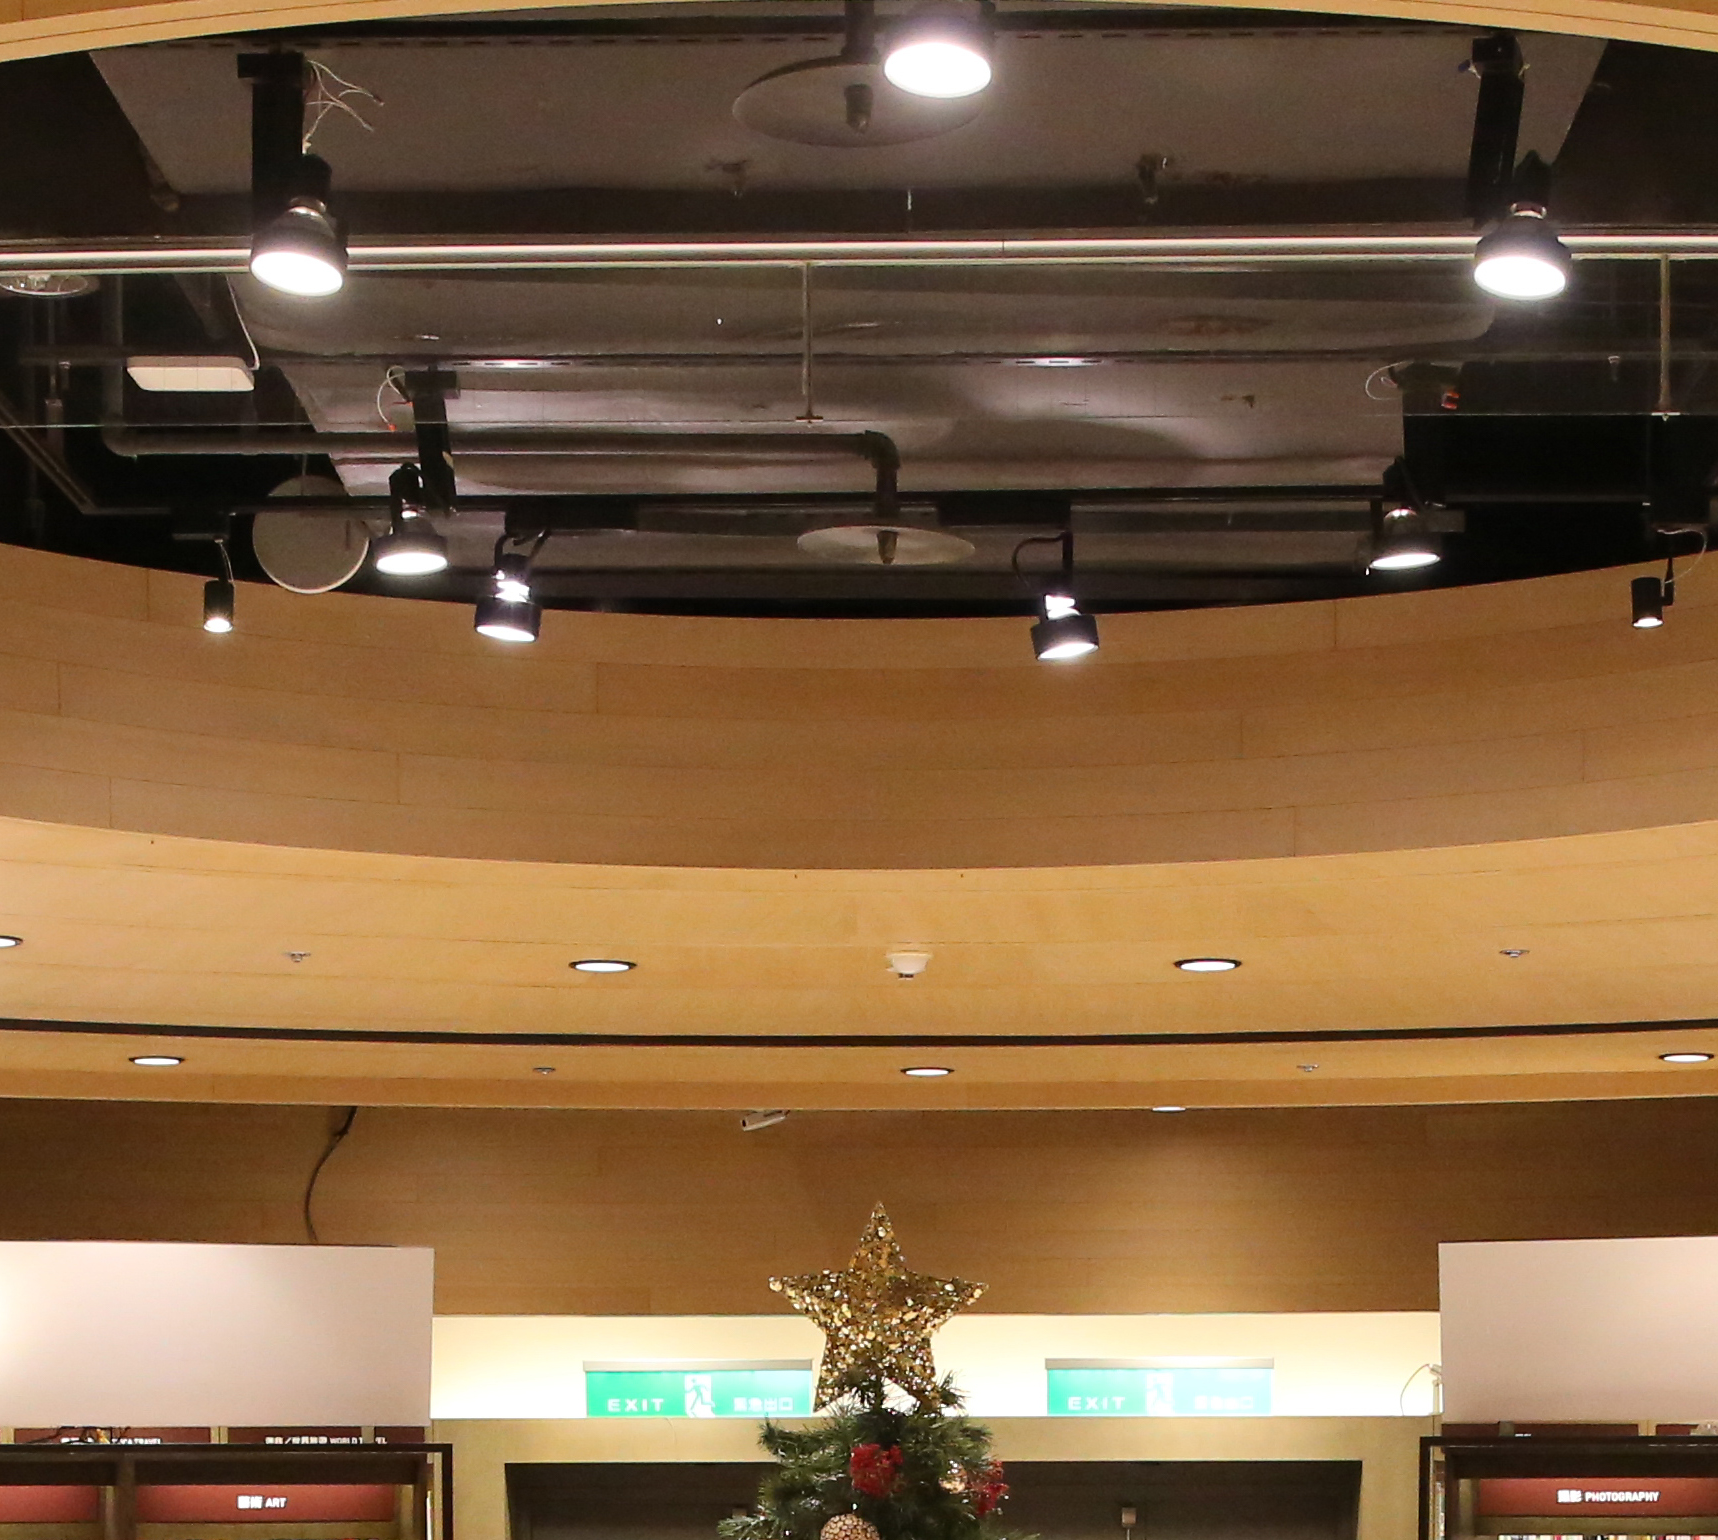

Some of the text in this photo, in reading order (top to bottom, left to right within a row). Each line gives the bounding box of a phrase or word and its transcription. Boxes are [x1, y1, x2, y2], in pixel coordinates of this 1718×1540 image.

[607, 1398, 664, 1412] EXIT
[1067, 1396, 1126, 1411] EXIT
[1584, 1490, 1661, 1502] PHOTOGRAPHY
[264, 1497, 287, 1509] ART
